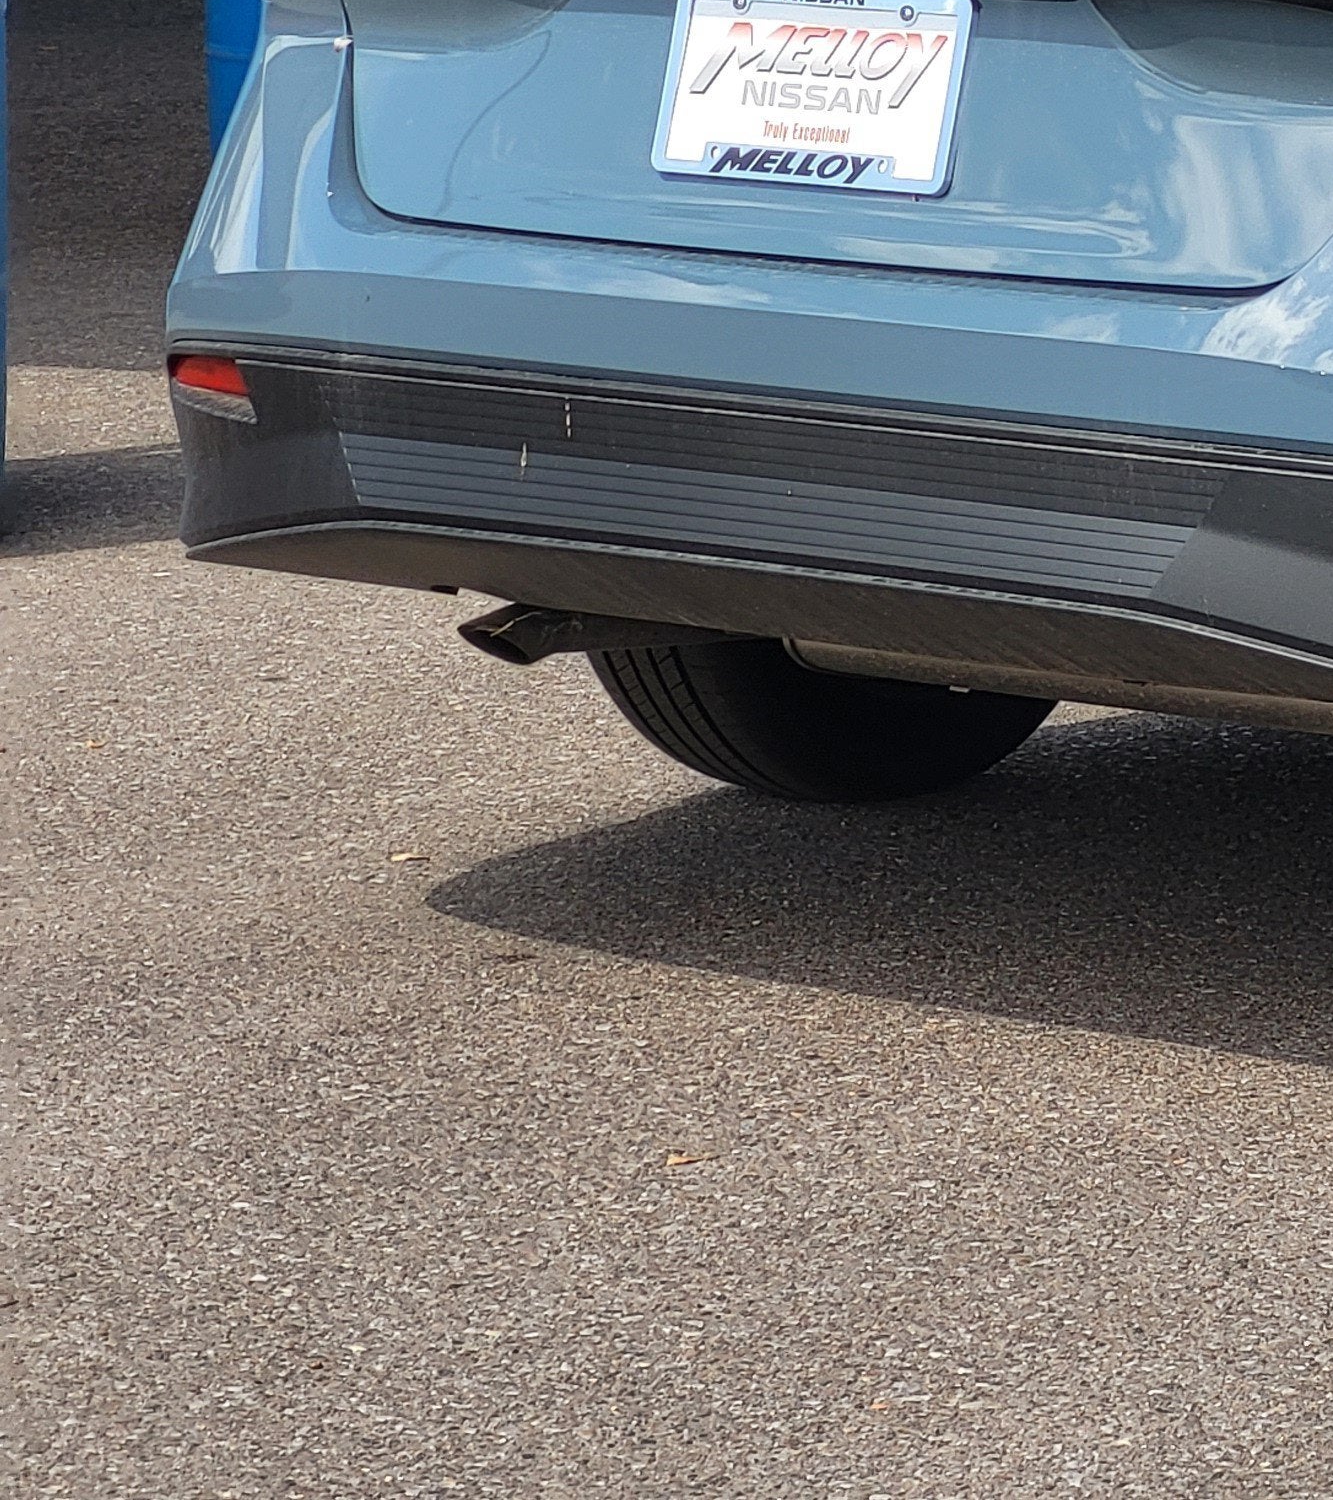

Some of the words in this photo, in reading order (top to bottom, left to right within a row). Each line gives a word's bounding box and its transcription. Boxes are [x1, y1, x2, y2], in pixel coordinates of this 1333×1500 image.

[689, 21, 949, 110] MELLOY
[740, 79, 882, 116] NISSAN
[762, 120, 789, 142] Truly
[792, 121, 851, 145] Exceptional
[709, 146, 874, 184] MELLOY
